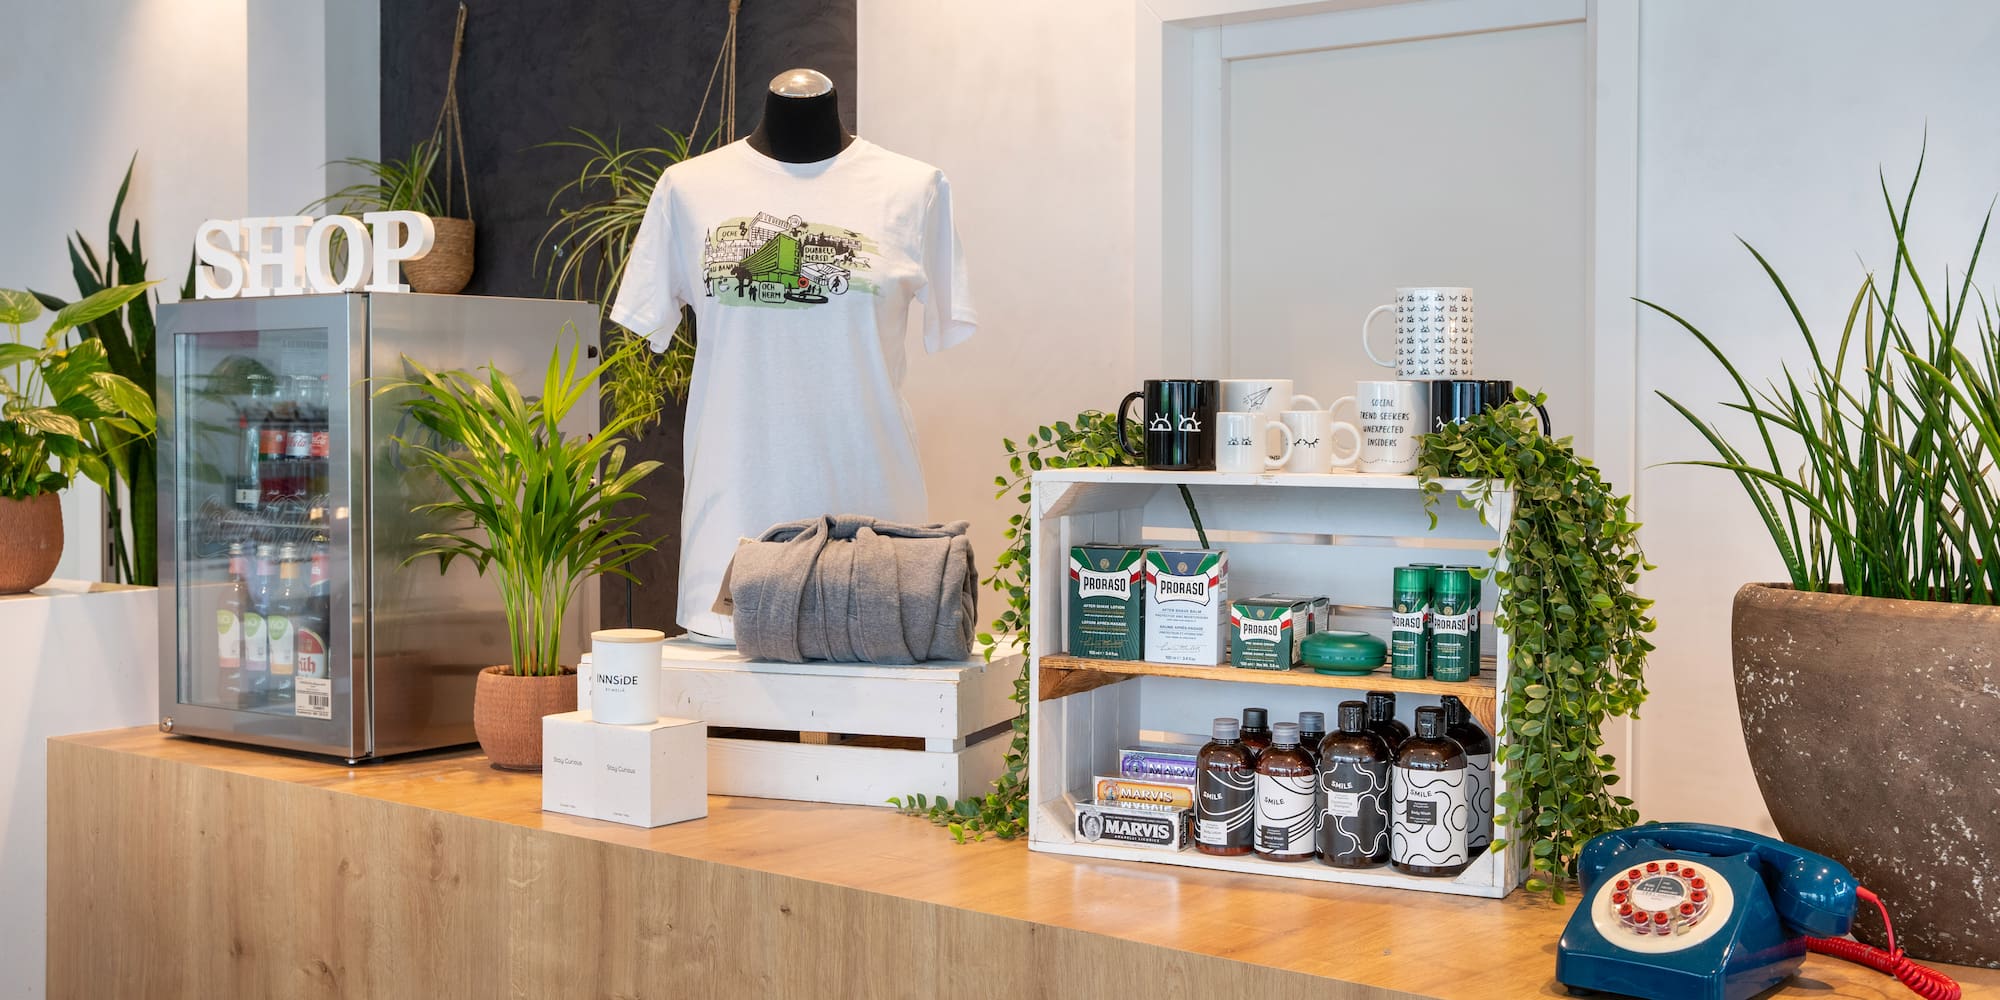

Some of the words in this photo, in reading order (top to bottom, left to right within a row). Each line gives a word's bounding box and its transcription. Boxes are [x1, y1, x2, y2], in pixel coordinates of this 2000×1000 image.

[195, 210, 435, 299] SHOP
[1371, 398, 1394, 407] SOCIAL
[1360, 411, 1378, 420] TREND
[1380, 412, 1410, 421] SEEKERS
[1363, 425, 1404, 434] UNEXPECTED
[1367, 437, 1398, 447] INSIDERS
[1083, 576, 1126, 592] PRORASO
[1160, 580, 1204, 596] PRORASO
[1243, 623, 1278, 637] PRORASO
[596, 672, 639, 686] INNSiDE
[1121, 787, 1174, 803] MARVIS
[1105, 819, 1170, 839] MARVIS
